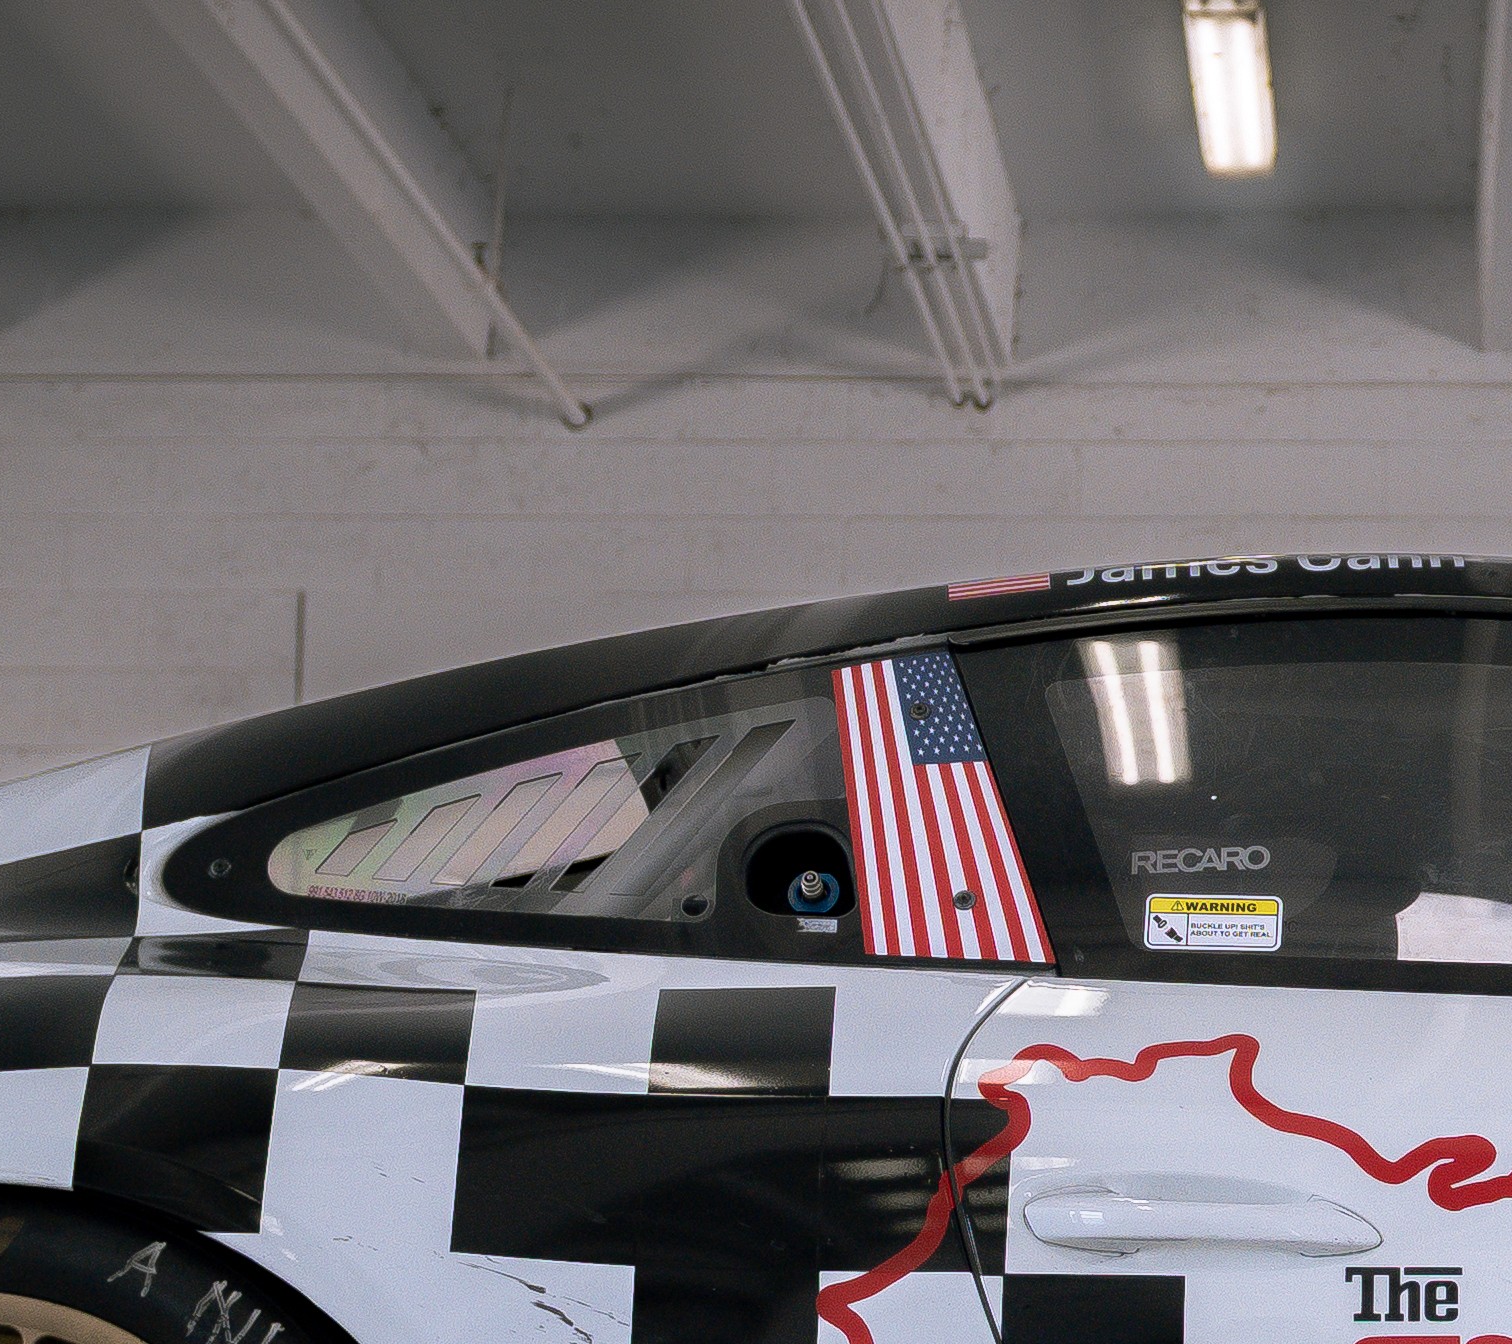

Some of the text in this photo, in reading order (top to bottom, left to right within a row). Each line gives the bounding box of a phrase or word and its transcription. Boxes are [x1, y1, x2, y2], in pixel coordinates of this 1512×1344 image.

[1131, 845, 1270, 875] RECARO
[1185, 902, 1257, 912] WARNING
[1345, 1266, 1463, 1322] The
